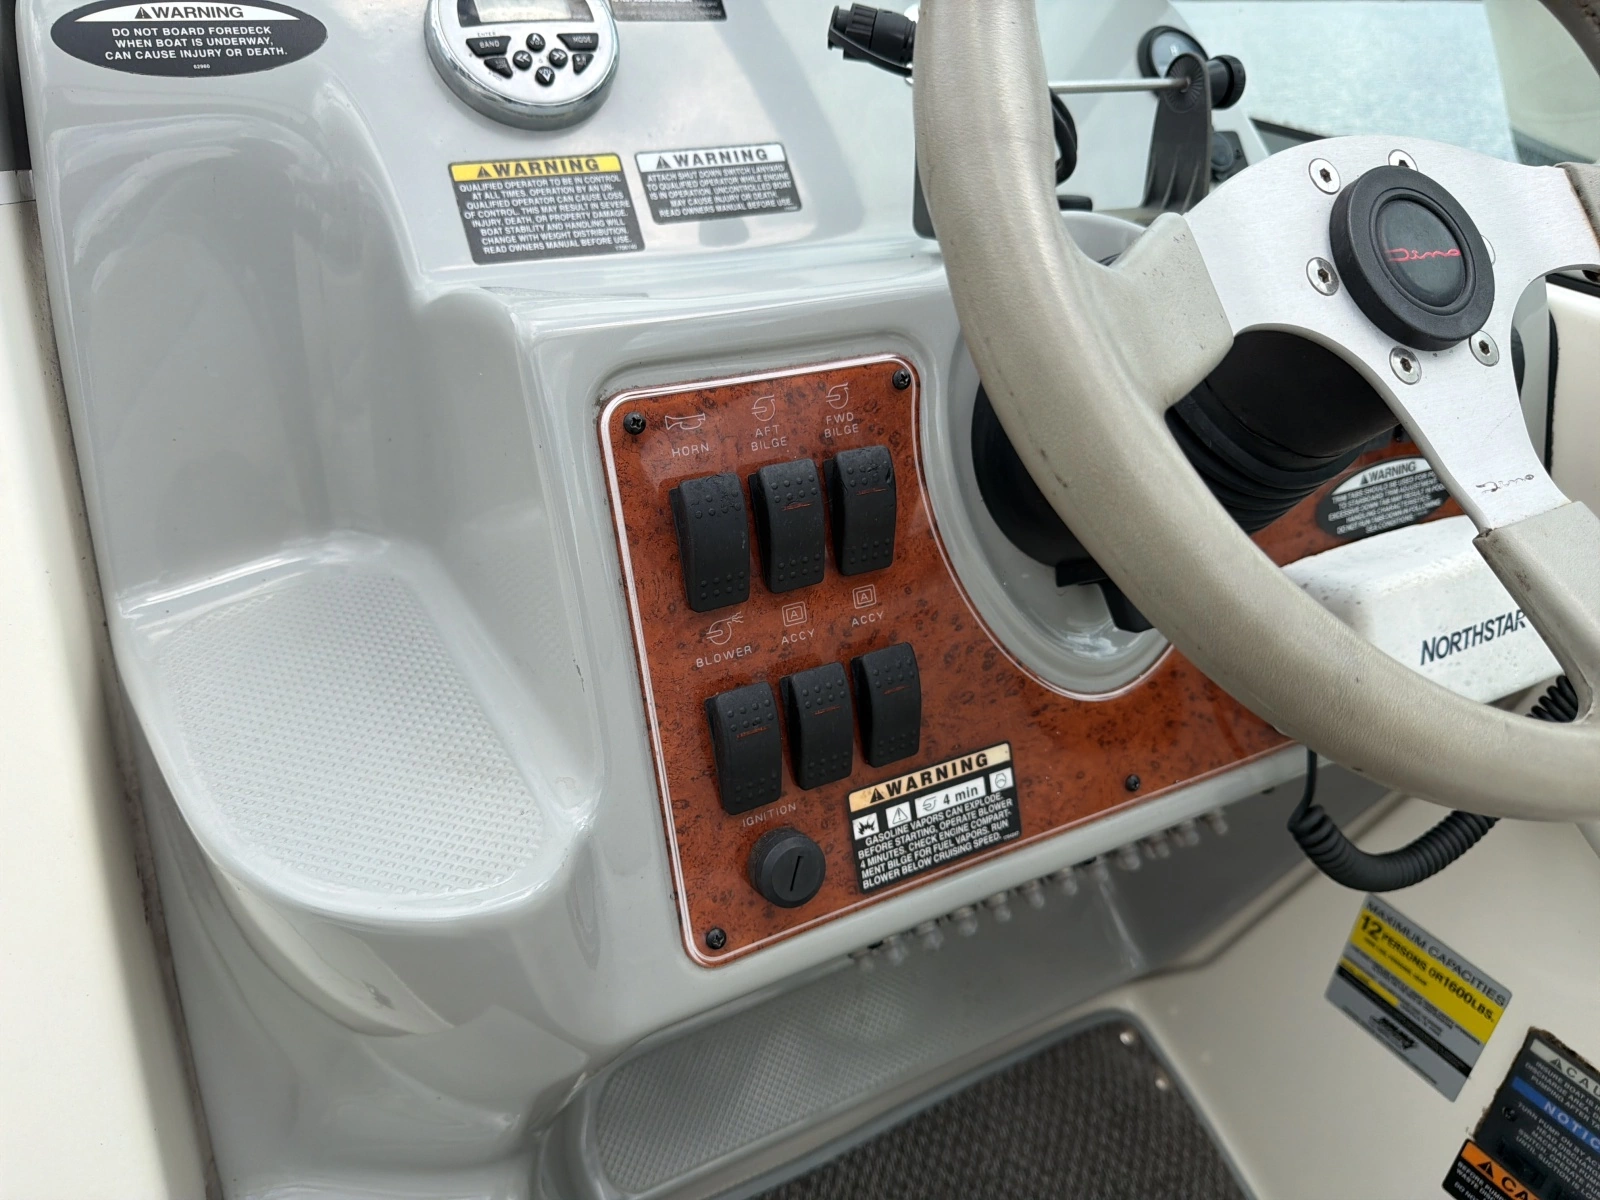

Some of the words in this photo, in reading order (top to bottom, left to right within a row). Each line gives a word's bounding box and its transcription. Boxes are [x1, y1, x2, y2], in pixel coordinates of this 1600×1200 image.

[151, 6, 244, 18] WARNING
[112, 28, 130, 36] DO
[134, 28, 158, 36] NOT
[163, 27, 204, 36] BOARD
[208, 26, 271, 35] FOREDECK
[115, 39, 152, 48] WHEN
[156, 39, 187, 47] BOAT
[192, 38, 203, 46] IS
[207, 37, 273, 46] UNDERWAY,
[105, 51, 131, 60] CAN
[135, 50, 176, 59] CAUSE
[180, 49, 221, 58] INJURY
[226, 48, 242, 57] OR
[246, 47, 287, 56] DEATH.
[672, 149, 768, 167] WARNING
[493, 158, 600, 176] WARNING
[459, 183, 503, 192] QUALIFIED
[504, 180, 548, 189] OPERATOR
[584, 176, 621, 184] CONTROL
[529, 187, 575, 196] OPERATION
[466, 200, 510, 210] QUALIFIED
[511, 197, 555, 206] OPERATOR
[549, 212, 591, 222] PROPERTY
[504, 225, 545, 234] STABILITY
[564, 220, 605, 230] HANDLING
[481, 236, 517, 245] CHANGE
[541, 232, 572, 240] WEIGHT
[483, 246, 508, 254] READ
[508, 243, 544, 252] OWNERS
[545, 240, 580, 249] MANUAL
[580, 238, 613, 246] BEFORE
[1385, 248, 1462, 262] Dino
[826, 412, 854, 425] FWD
[755, 424, 779, 438] AFT
[824, 423, 859, 438] BILGE
[671, 443, 710, 458] HORN
[750, 437, 788, 451] BILGE
[1369, 461, 1416, 483] WARNING
[851, 611, 884, 627] ACCY
[781, 628, 815, 645] ACCY
[1420, 609, 1526, 666] NORTHSTAR
[696, 646, 752, 668] BLOWER
[886, 753, 988, 797] WARNING
[943, 794, 950, 805] 4
[955, 786, 978, 802] min
[742, 803, 797, 827] IGNITION
[865, 824, 909, 847] GASOLINE
[910, 812, 944, 831] VAPORS
[945, 805, 963, 818] CAN
[965, 791, 1003, 812] EXPLODE.
[858, 840, 893, 860] BEFORE
[939, 810, 977, 831] OPERATE
[978, 798, 1012, 817] BLOWER
[859, 860, 866, 869] 4
[867, 845, 906, 867] MINUTES.
[908, 834, 937, 852] CHECK
[939, 823, 969, 840] ENGINE
[970, 807, 1012, 829] COMPART-
[861, 863, 886, 879] MENT
[887, 853, 912, 870] BILGE
[914, 846, 931, 860] FOR
[933, 838, 954, 852] FUEL
[956, 825, 989, 844] VAPORS.
[991, 819, 1008, 832] RUN
[862, 868, 900, 889] BLOWER
[901, 856, 932, 875] BELOW
[933, 842, 972, 863] CRUISING
[973, 831, 1001, 848] SPEED.
[1362, 916, 1382, 940] 12
[1382, 932, 1427, 970] PERSONS
[1367, 903, 1426, 948] MAXIMUM
[1429, 946, 1505, 1006] CAPACITIES
[1564, 1082, 1585, 1099] BOAT
